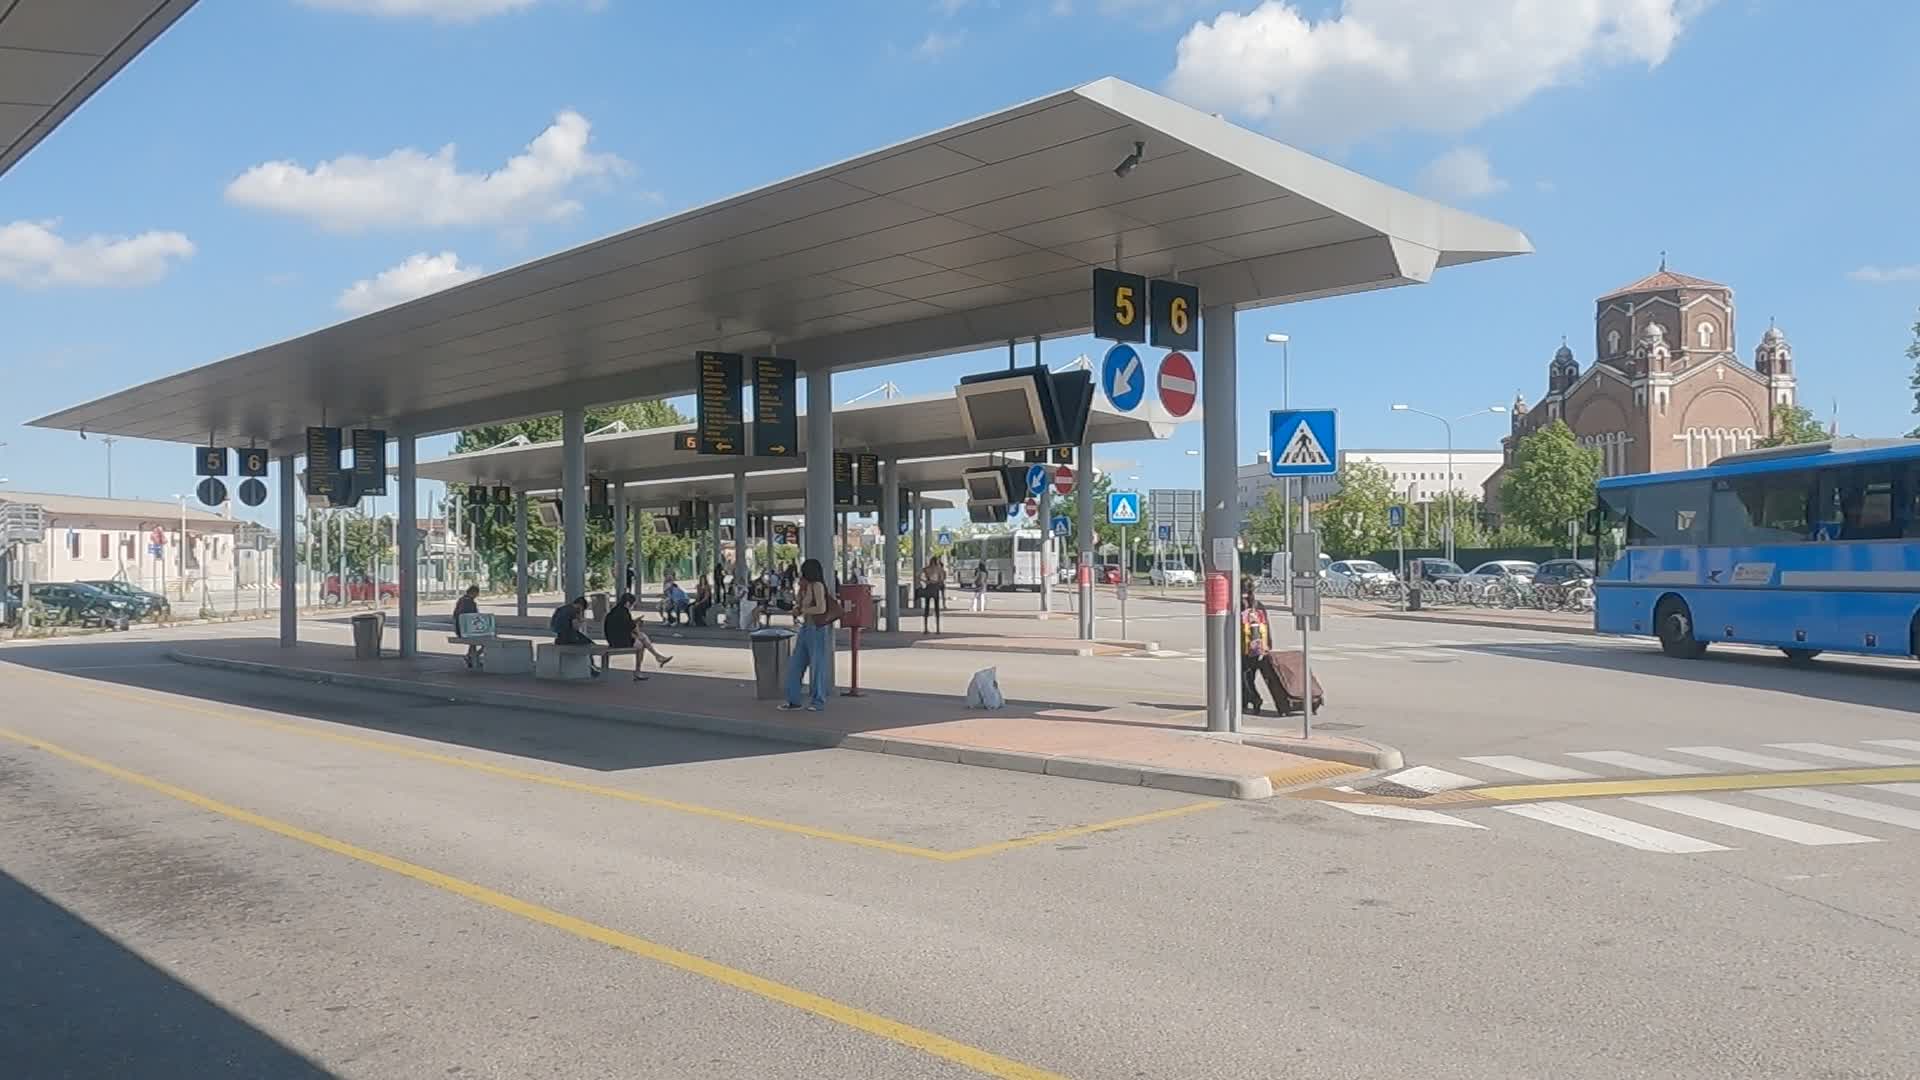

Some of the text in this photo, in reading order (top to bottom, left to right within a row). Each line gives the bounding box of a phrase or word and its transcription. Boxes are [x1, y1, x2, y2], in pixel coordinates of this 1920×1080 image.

[1116, 287, 1134, 325] 5
[1171, 297, 1187, 334] 6
[208, 453, 220, 470] 5
[248, 454, 261, 471] 6
